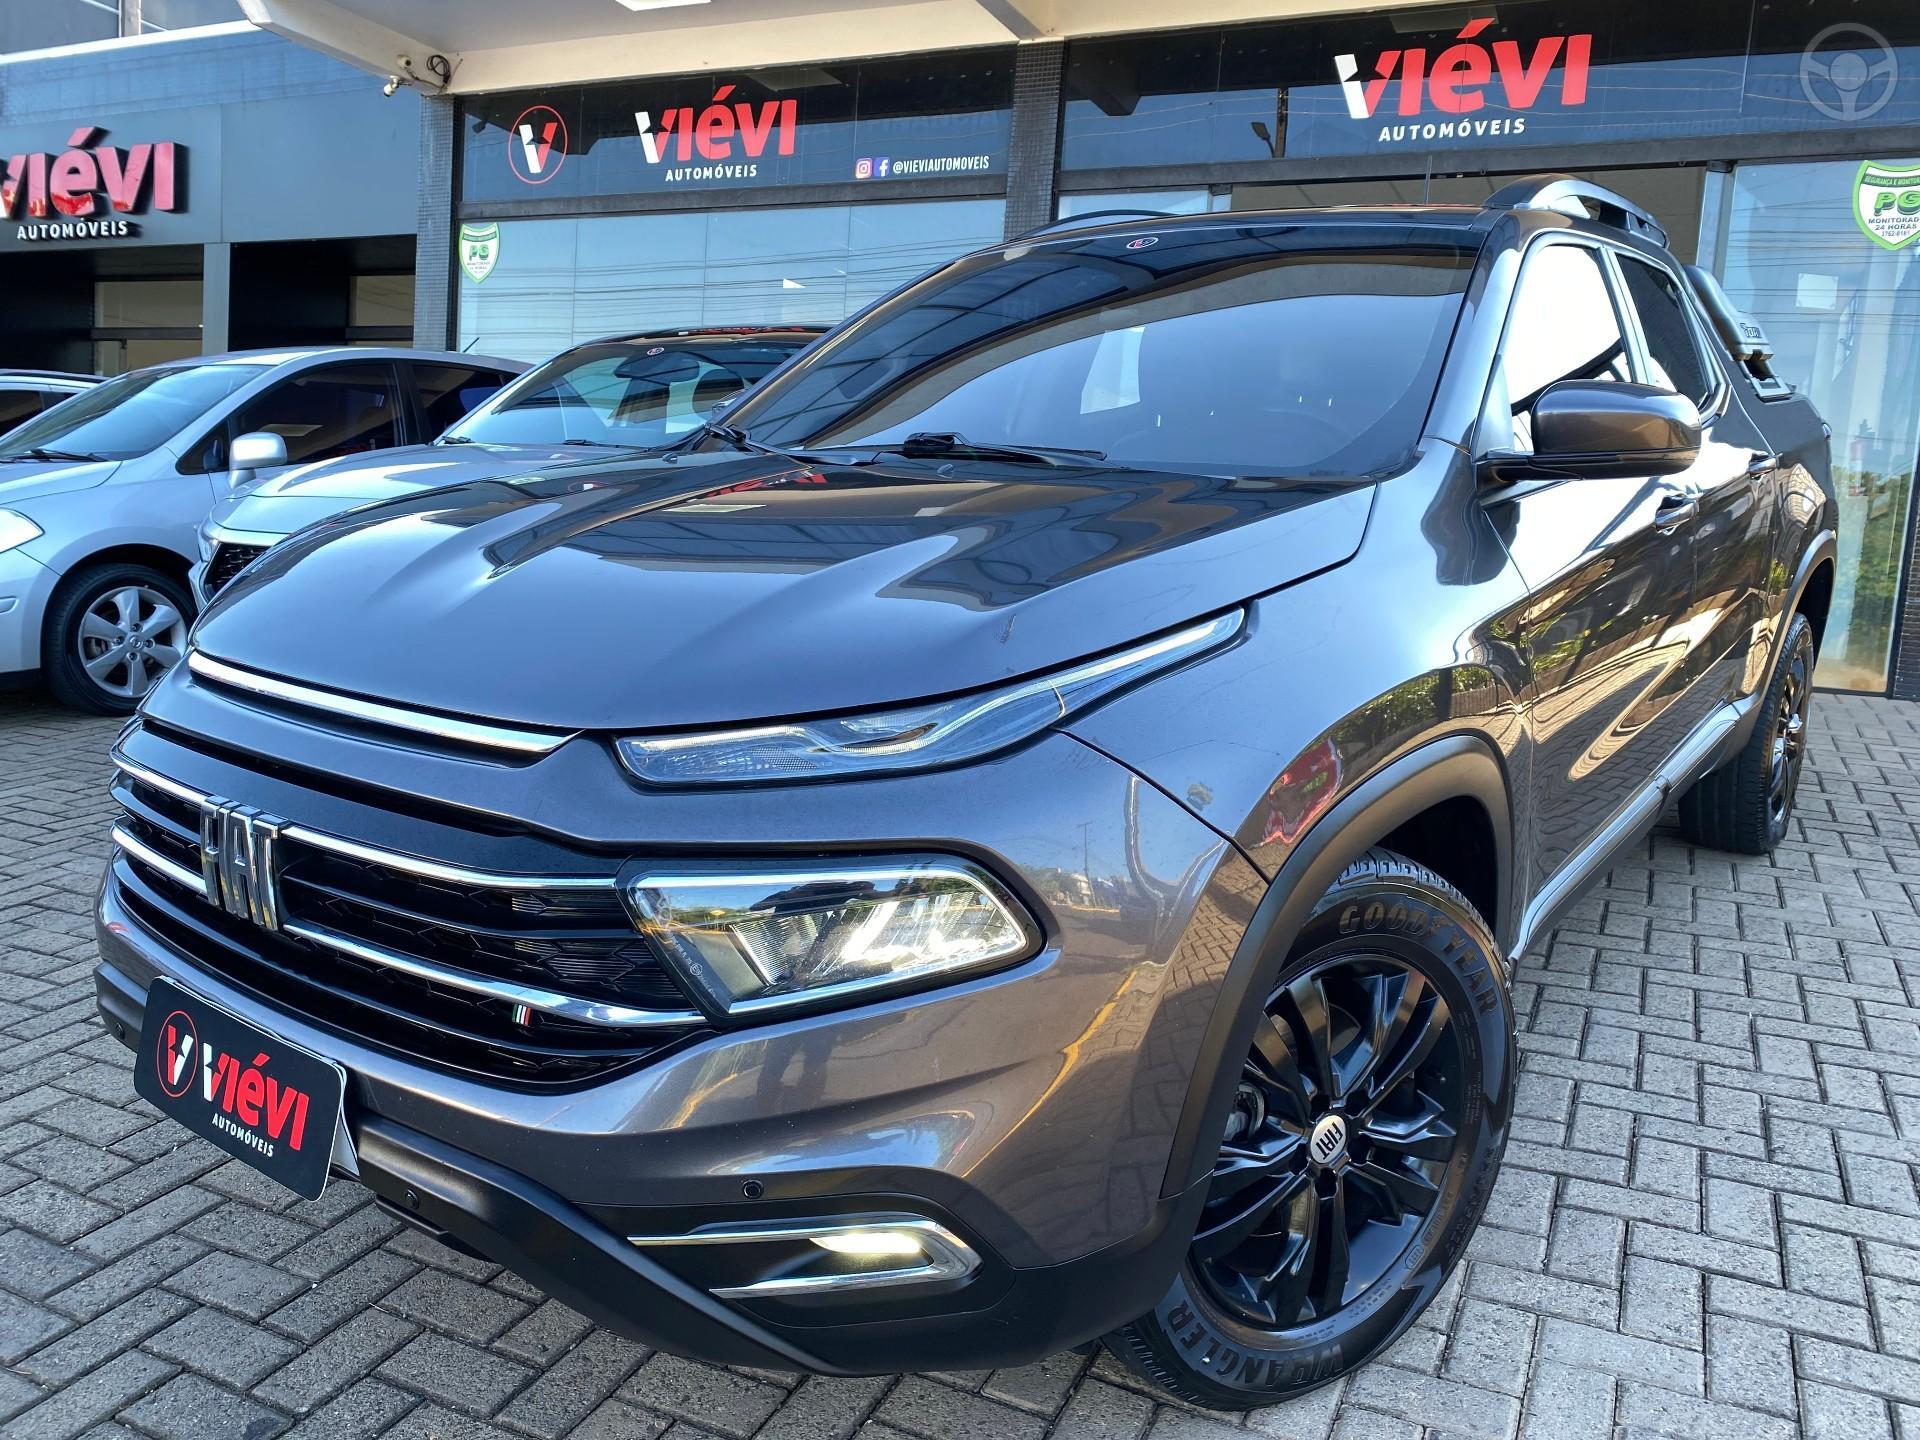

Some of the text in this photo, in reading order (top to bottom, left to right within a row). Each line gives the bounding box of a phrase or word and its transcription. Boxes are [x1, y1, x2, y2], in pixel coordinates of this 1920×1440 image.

[1378, 118, 1526, 142] AUTOMÓVEIS
[665, 163, 758, 182] AUTOMÓVEIS
[892, 155, 990, 174] @VIEVIAUTOMOVEIS
[16, 217, 129, 240] AUTOMÓVEIS
[1339, 901, 1498, 1014] GOODYEAR
[212, 1112, 274, 1158] AUTOMÓVEIS
[1315, 1121, 1344, 1160] FIAT
[1167, 1299, 1344, 1387] WRANGLER
